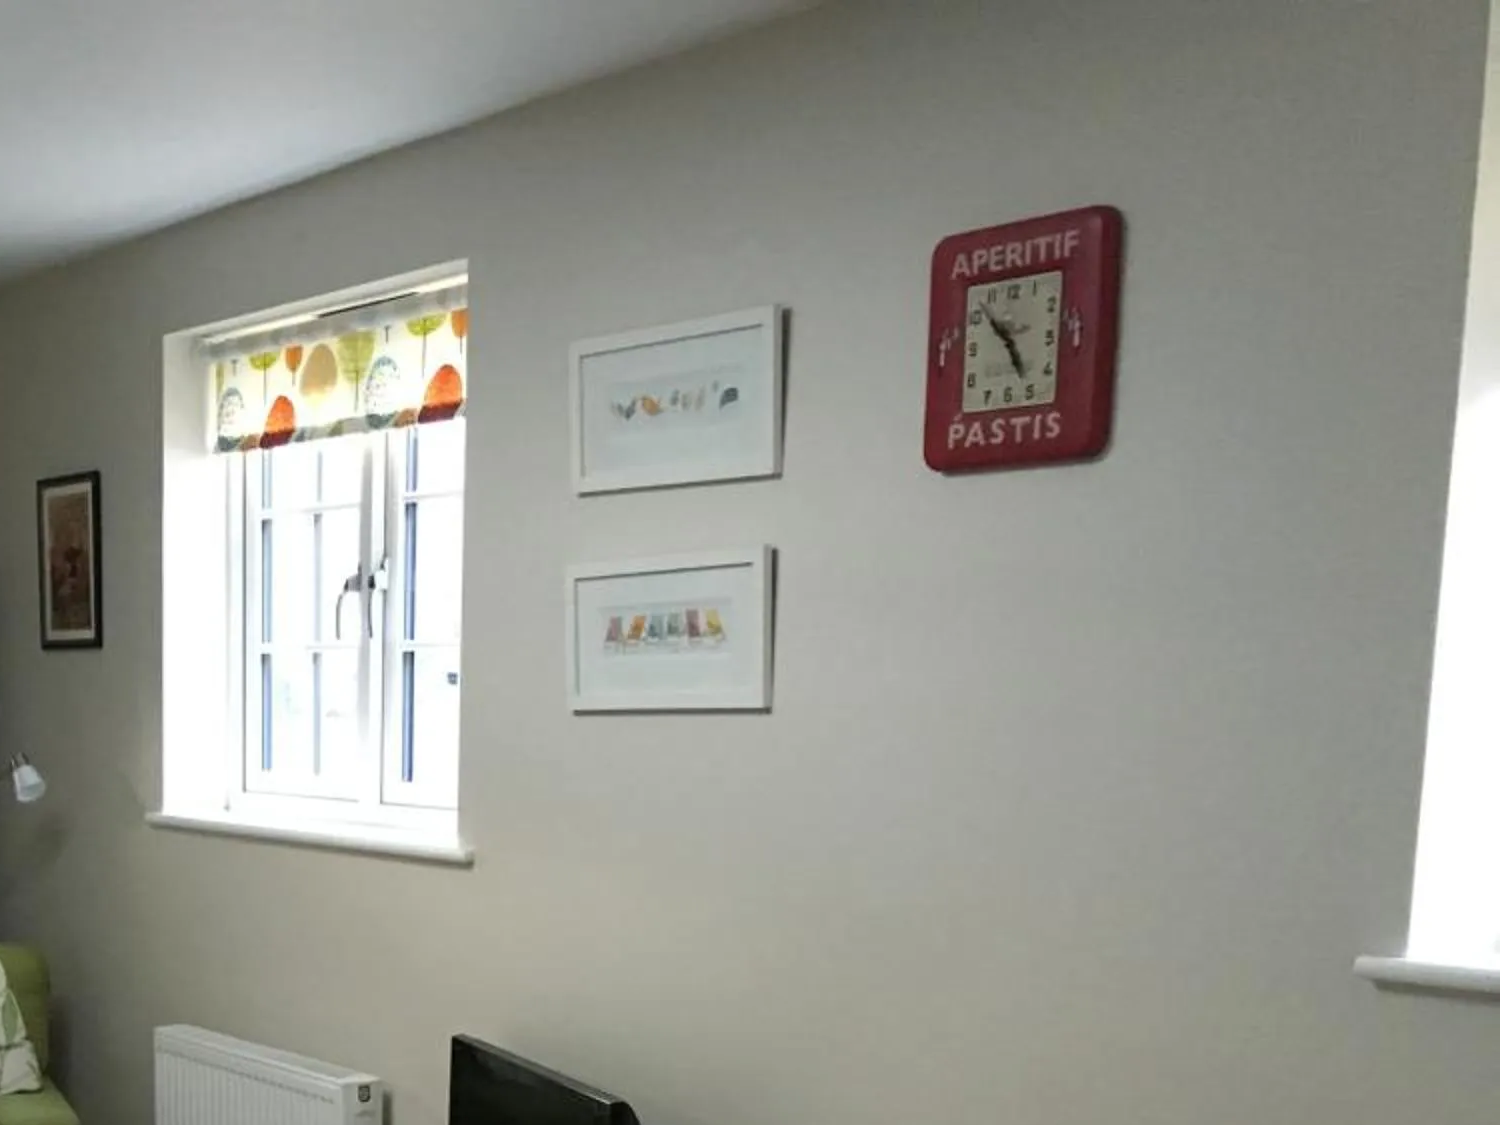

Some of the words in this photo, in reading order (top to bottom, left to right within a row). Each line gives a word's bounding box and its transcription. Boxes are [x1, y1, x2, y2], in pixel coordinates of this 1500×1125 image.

[952, 230, 1080, 278] APERITIF
[987, 288, 997, 304] 11
[1007, 284, 1021, 300] 12
[982, 389, 992, 406] 7
[1003, 386, 1013, 403] 6
[1025, 383, 1035, 400] 5
